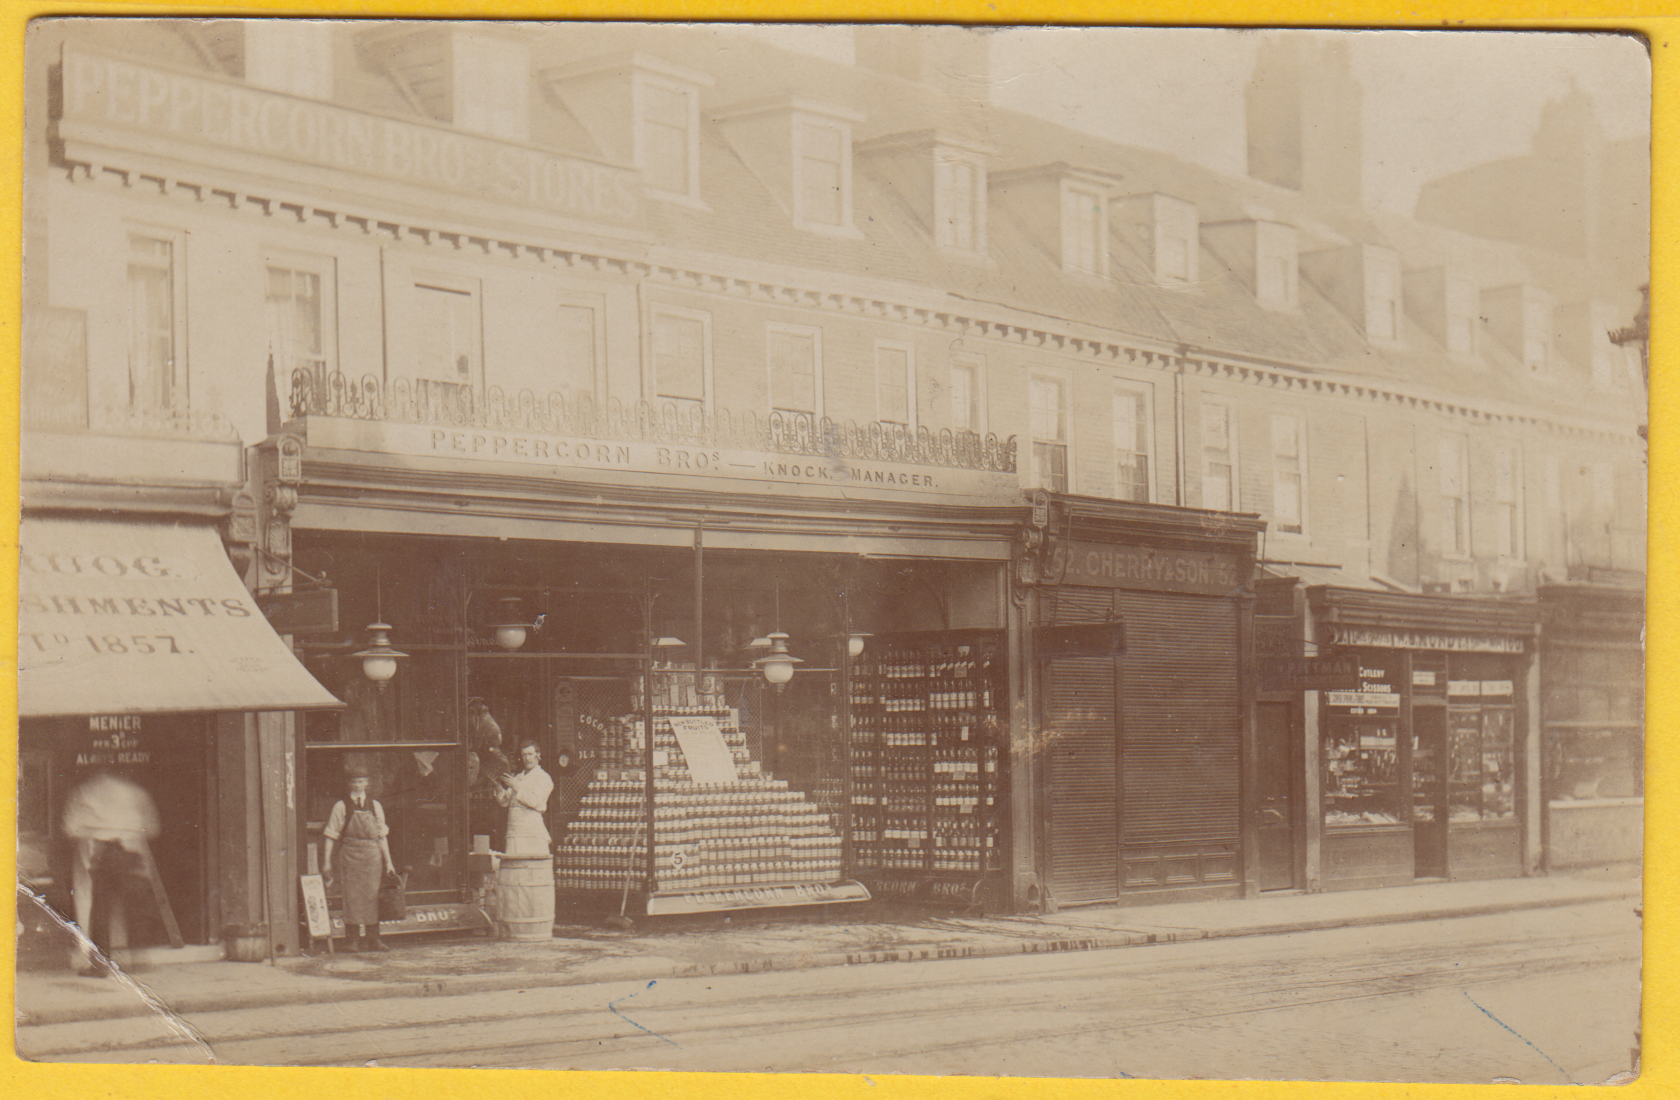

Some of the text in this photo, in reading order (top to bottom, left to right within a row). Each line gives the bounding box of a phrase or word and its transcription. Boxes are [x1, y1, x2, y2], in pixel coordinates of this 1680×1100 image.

[71, 57, 380, 177] PEPPERCORN
[495, 144, 640, 220] STORES
[429, 428, 631, 465] PEPPERCORN
[851, 467, 939, 488] MANAGER.
[85, 634, 195, 655] 1857.
[88, 715, 142, 731] MENIER
[685, 718, 715, 727] BOTTLED
[92, 739, 110, 749] PER
[120, 739, 139, 749] CUP
[117, 751, 152, 764] READY
[673, 852, 683, 865] 5
[683, 887, 785, 904] PEPPERCORN
